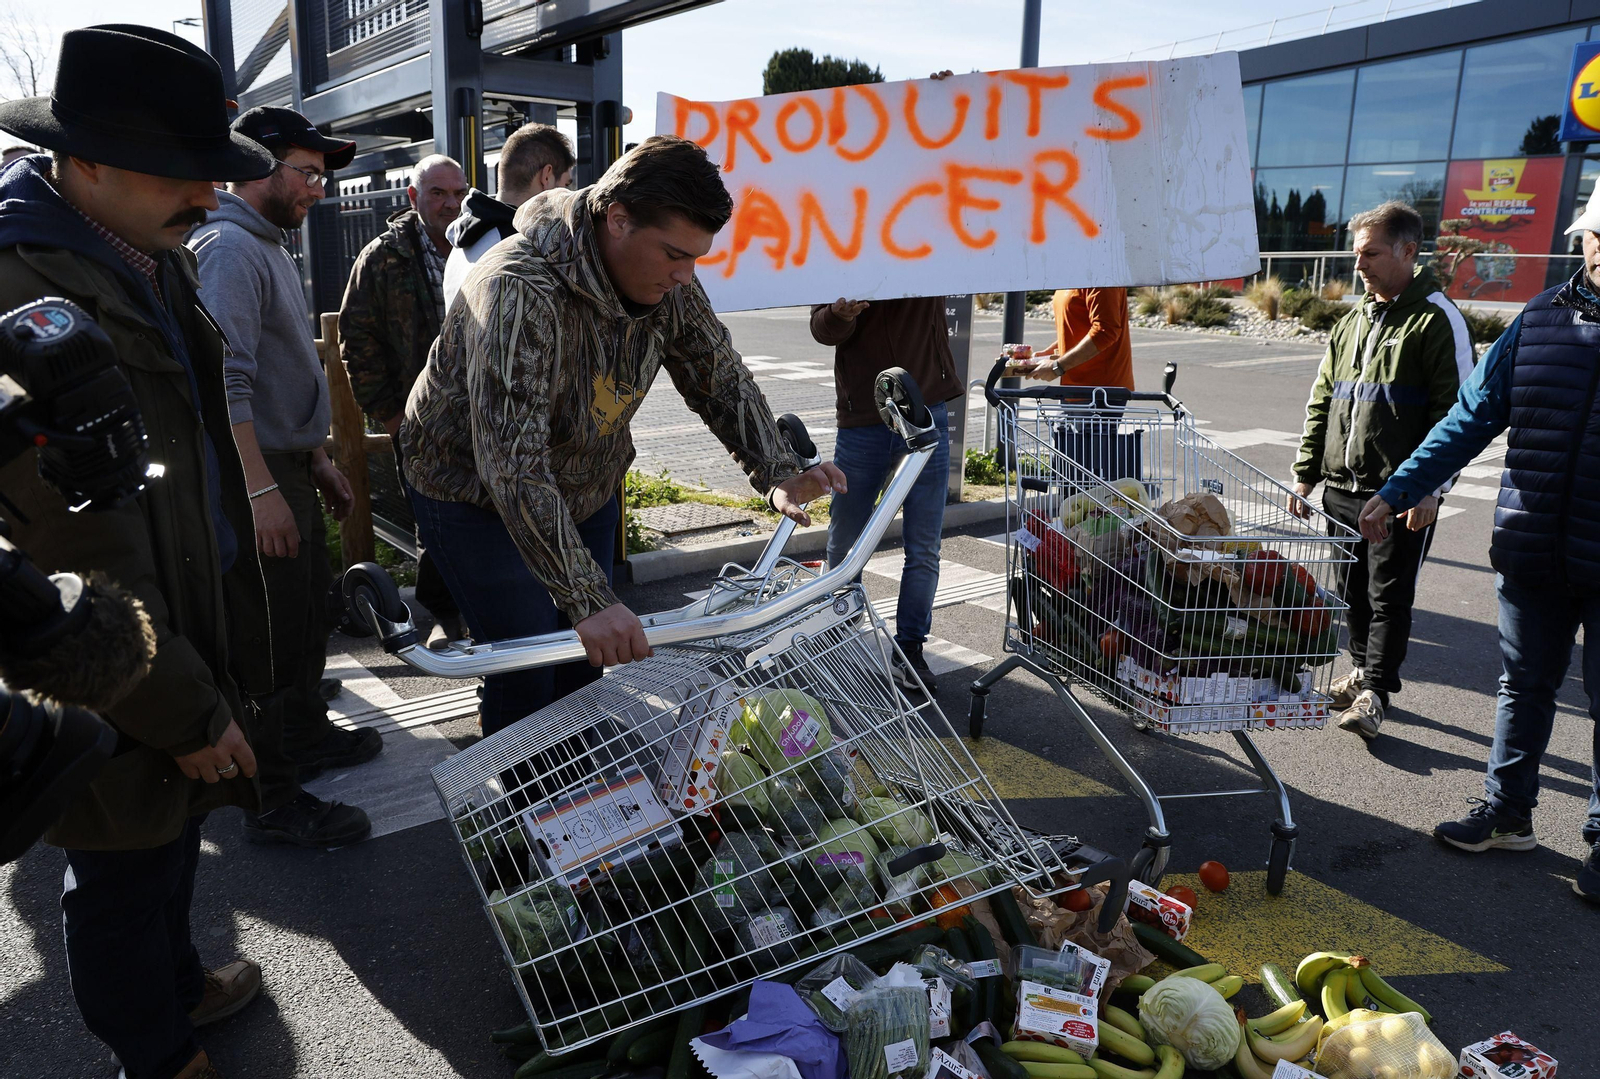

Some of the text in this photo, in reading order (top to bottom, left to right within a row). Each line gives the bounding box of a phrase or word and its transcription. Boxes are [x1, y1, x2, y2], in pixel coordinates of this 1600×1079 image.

[672, 70, 1149, 173] PRODUITS
[695, 148, 1100, 279] ANCER
[1461, 207, 1497, 215] CONTRE
[1128, 892, 1148, 906] Azura
[1093, 963, 1106, 986] Azura
[1470, 1044, 1491, 1054] Azura
[937, 1053, 962, 1075] Azura
[1463, 1056, 1484, 1071] Azura
